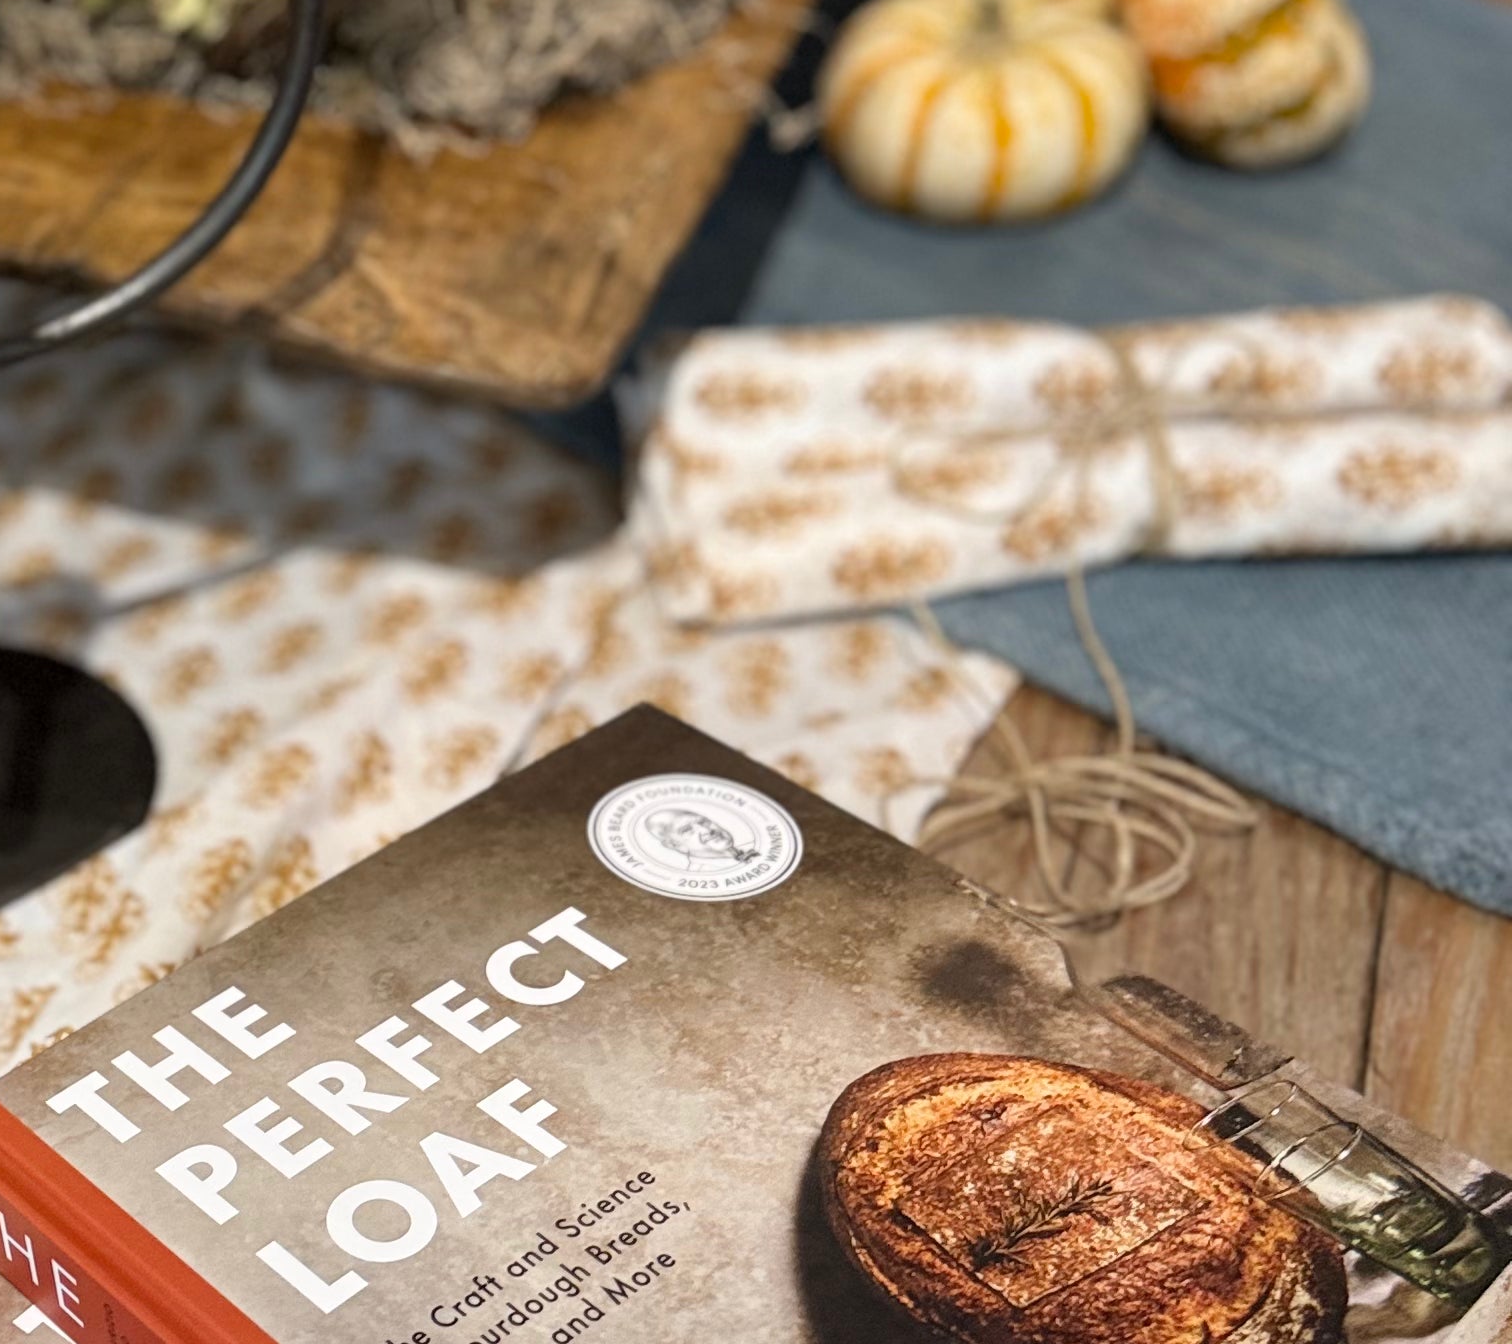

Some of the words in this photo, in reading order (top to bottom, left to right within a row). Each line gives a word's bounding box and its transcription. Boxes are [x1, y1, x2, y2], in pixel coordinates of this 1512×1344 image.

[608, 800, 635, 832] BEARD
[637, 785, 745, 807] FOUNDATION
[609, 835, 641, 868] JAMES
[678, 878, 719, 889] 2023
[725, 862, 771, 888] AWARD
[767, 824, 784, 863] WINNER
[46, 986, 296, 1143] THE
[155, 906, 628, 1225] PERFECT
[255, 1078, 568, 1314] LOAF
[430, 1275, 504, 1328] Craft
[507, 1232, 558, 1277] and
[555, 1169, 656, 1238] Science
[585, 1201, 691, 1265] Breads,
[602, 1250, 676, 1305] More
